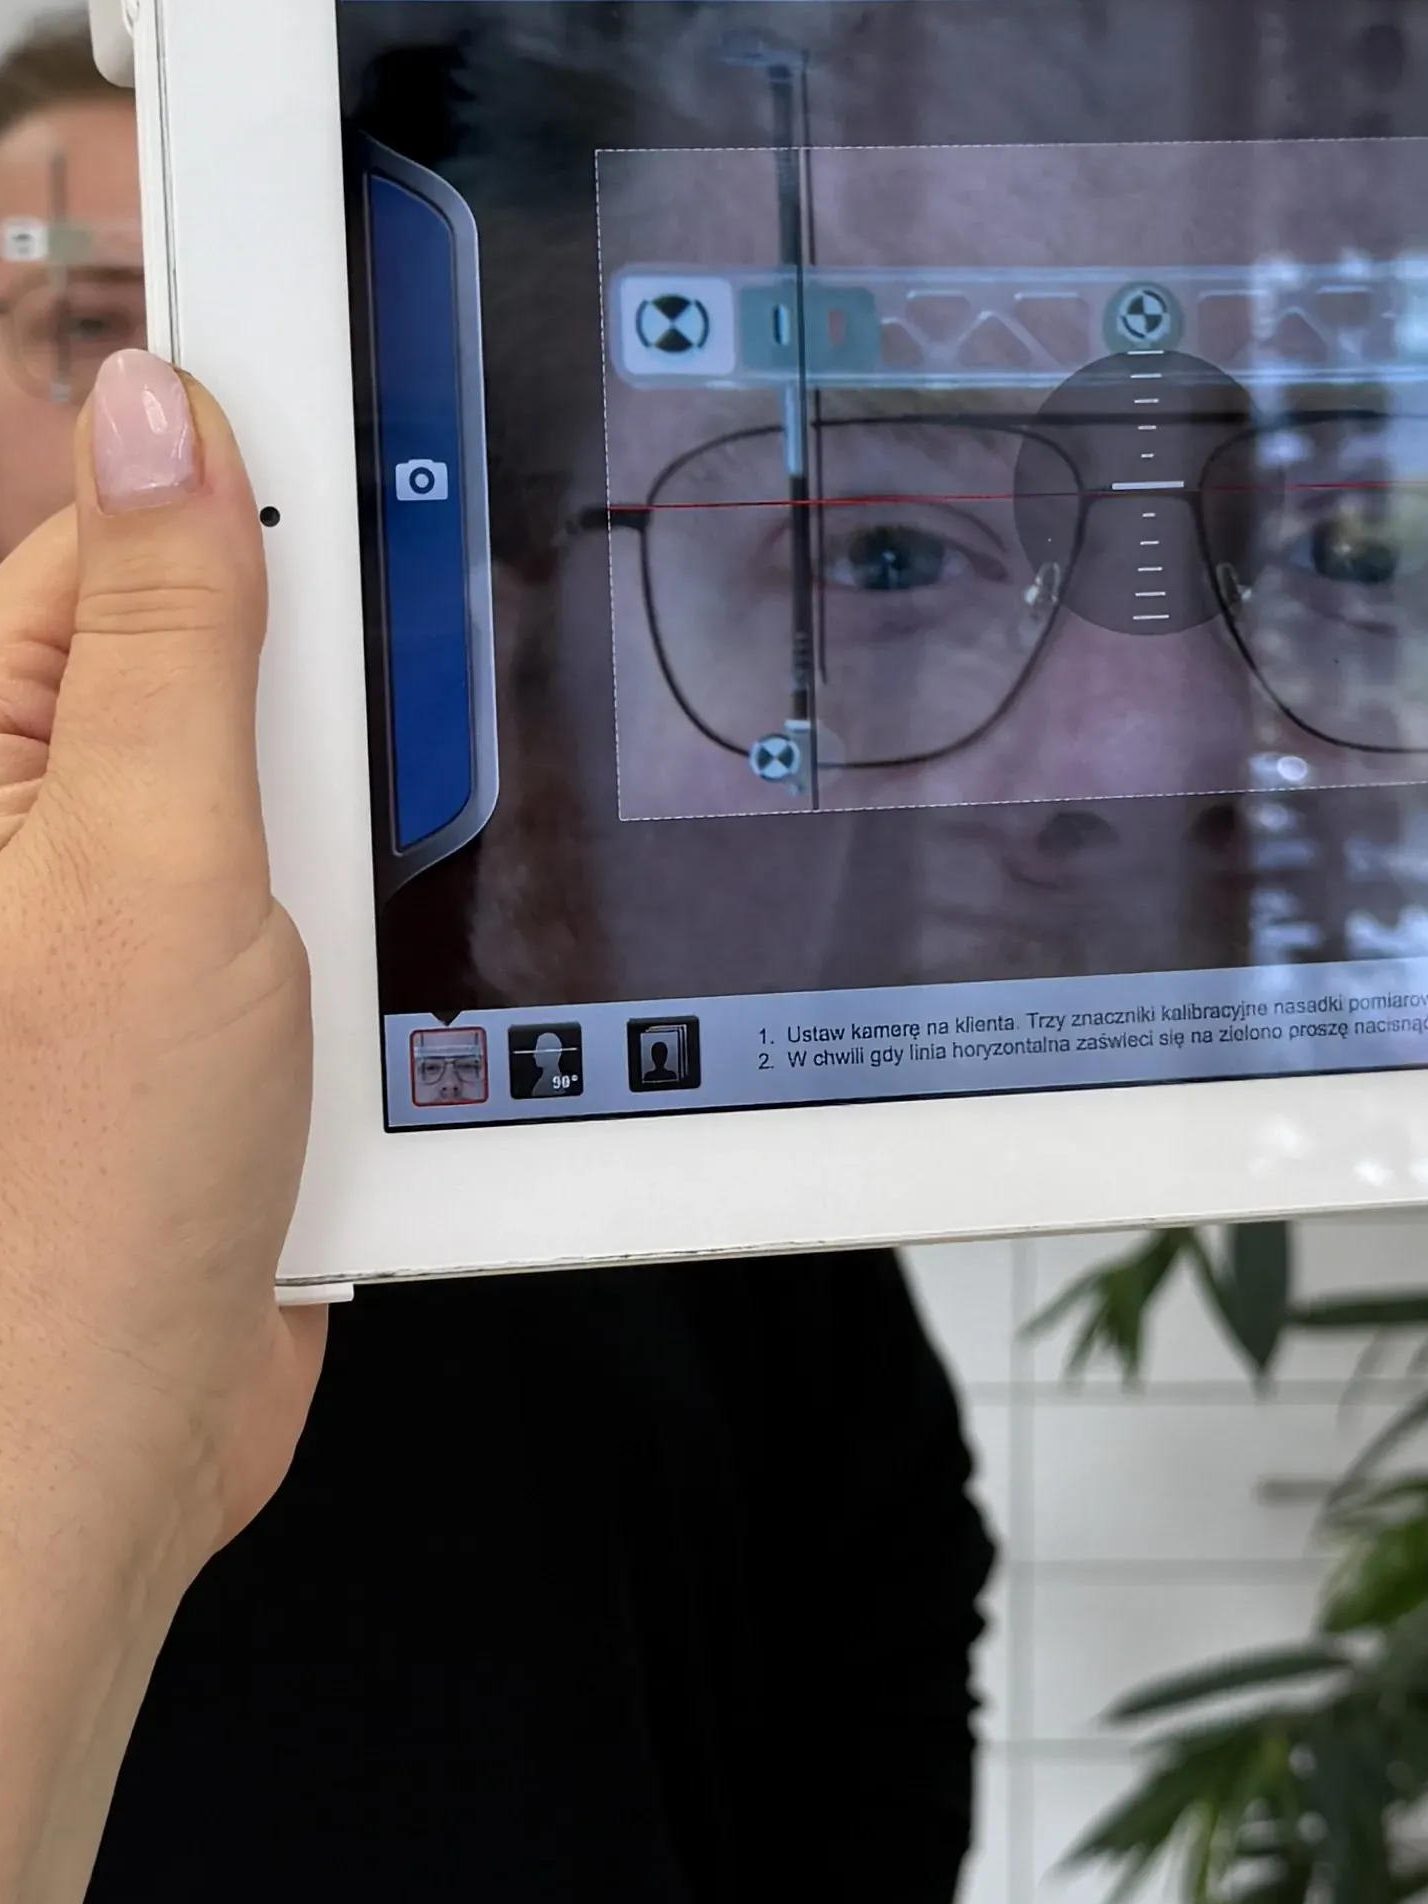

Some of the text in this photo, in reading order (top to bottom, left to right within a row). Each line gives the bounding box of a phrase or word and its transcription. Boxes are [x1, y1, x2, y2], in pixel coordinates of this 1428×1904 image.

[759, 1028, 774, 1045] 1.
[787, 1025, 845, 1043] Ustaw
[851, 1022, 920, 1040] kamerę
[927, 1021, 949, 1036] na
[1026, 1011, 1065, 1031] Trzy
[1071, 1005, 1155, 1027] znaczniki
[1161, 1000, 1267, 1021] kalibracyjne
[1274, 995, 1343, 1015] nasadki
[758, 1053, 774, 1069] 2.
[787, 1051, 806, 1068] W
[813, 1048, 864, 1066] chwili
[871, 1046, 904, 1067] gdy
[910, 1043, 947, 1061] linia
[953, 1036, 1070, 1061] horyzontalna
[1076, 1030, 1153, 1051] zaświeci
[1160, 1028, 1184, 1048] się
[1191, 1029, 1213, 1044] na
[1219, 1024, 1282, 1042] zielono
[1289, 1022, 1349, 1040] proszę
